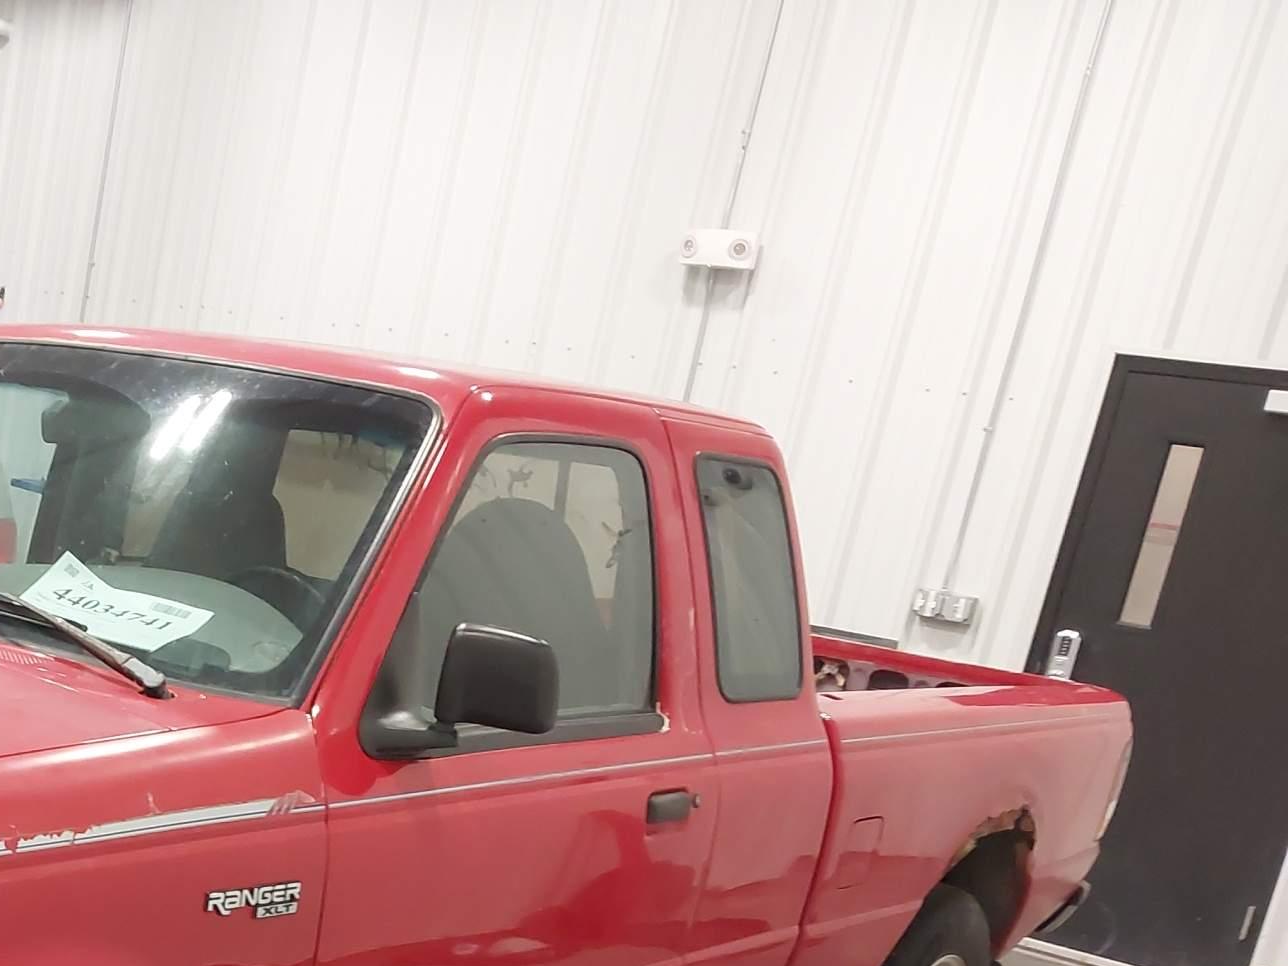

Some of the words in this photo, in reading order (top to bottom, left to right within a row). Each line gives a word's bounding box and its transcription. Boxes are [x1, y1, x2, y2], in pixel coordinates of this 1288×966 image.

[52, 587, 173, 630] 44034741
[206, 881, 302, 916] RANGER
[260, 903, 296, 917] XLT
